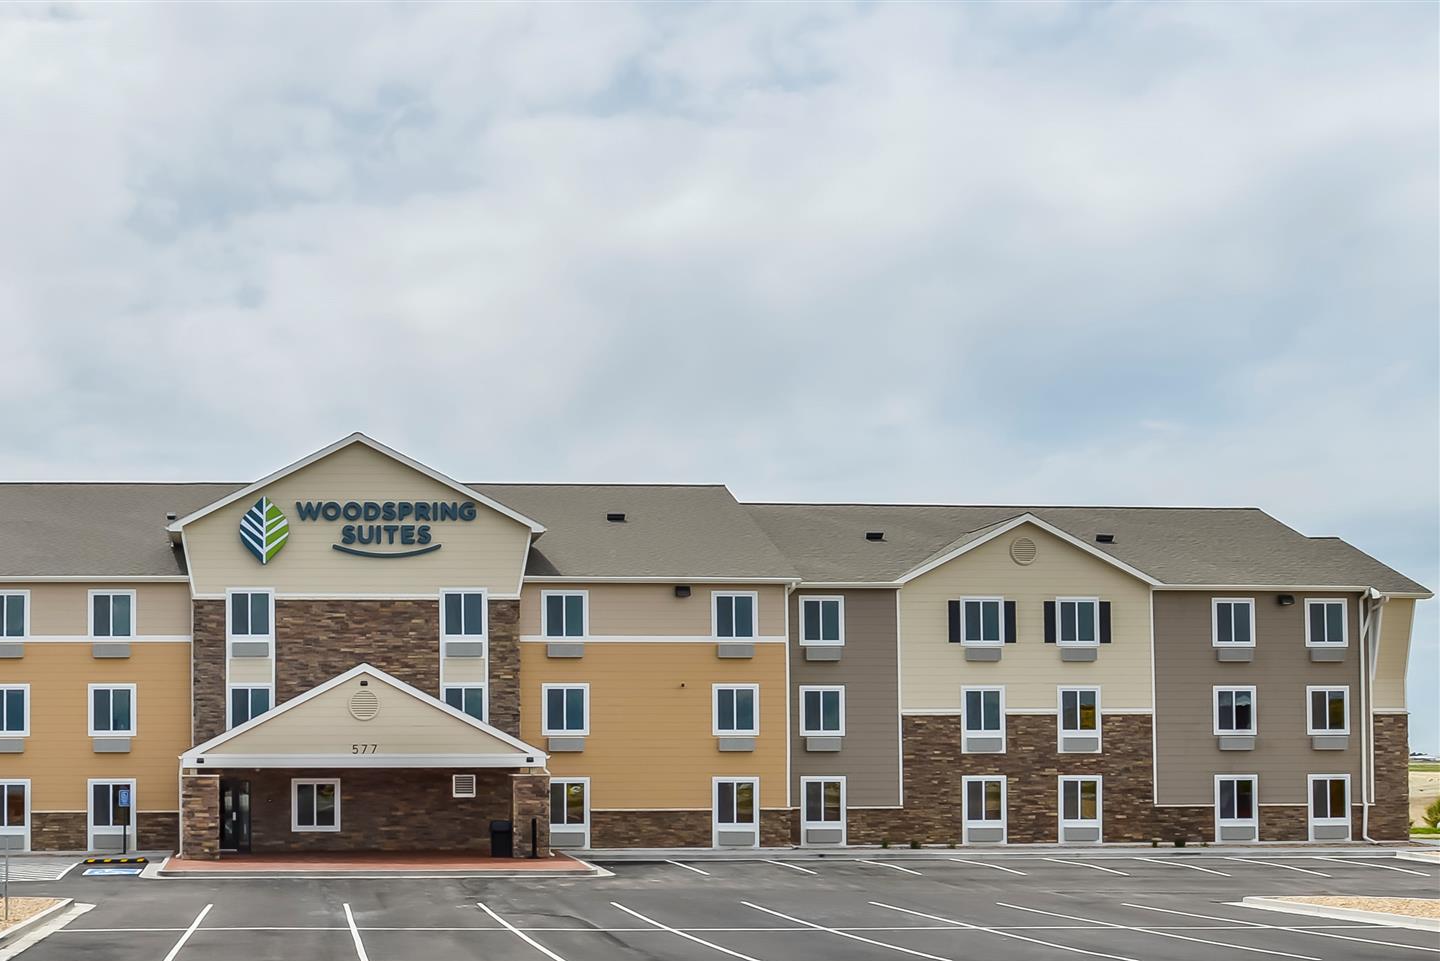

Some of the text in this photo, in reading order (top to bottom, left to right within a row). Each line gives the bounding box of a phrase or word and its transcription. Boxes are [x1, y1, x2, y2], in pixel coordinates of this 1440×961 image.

[295, 501, 477, 522] WOODSPRING
[341, 524, 432, 545] SUITES
[352, 744, 378, 755] 577
